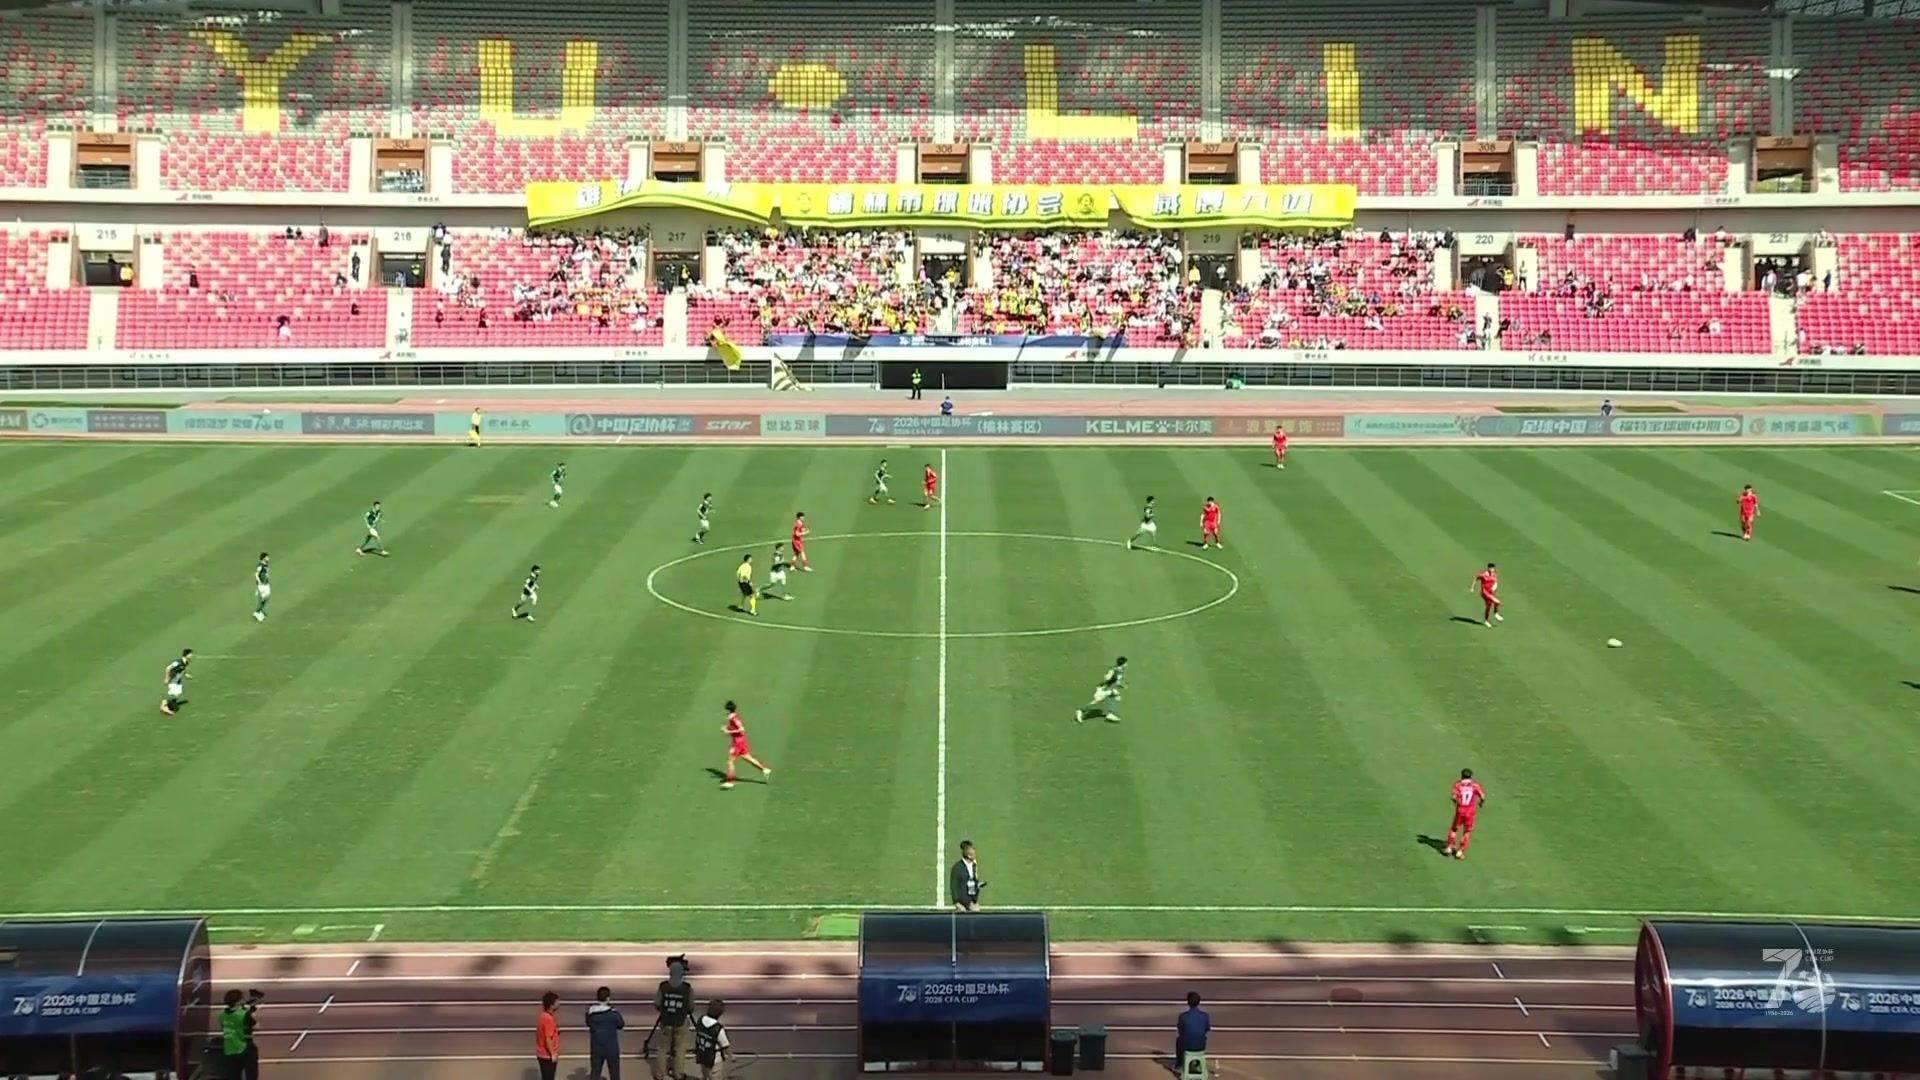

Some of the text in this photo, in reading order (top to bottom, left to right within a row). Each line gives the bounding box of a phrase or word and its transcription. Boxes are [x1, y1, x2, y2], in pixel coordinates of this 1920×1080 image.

[1475, 234, 1494, 245] 220
[1769, 233, 1789, 244] 221
[1086, 420, 1154, 434] KELME
[1521, 420, 1588, 434] 足球中国
[924, 983, 1010, 995] 2026中国足协杯
[42, 993, 136, 1007] 2026中国足协杯
